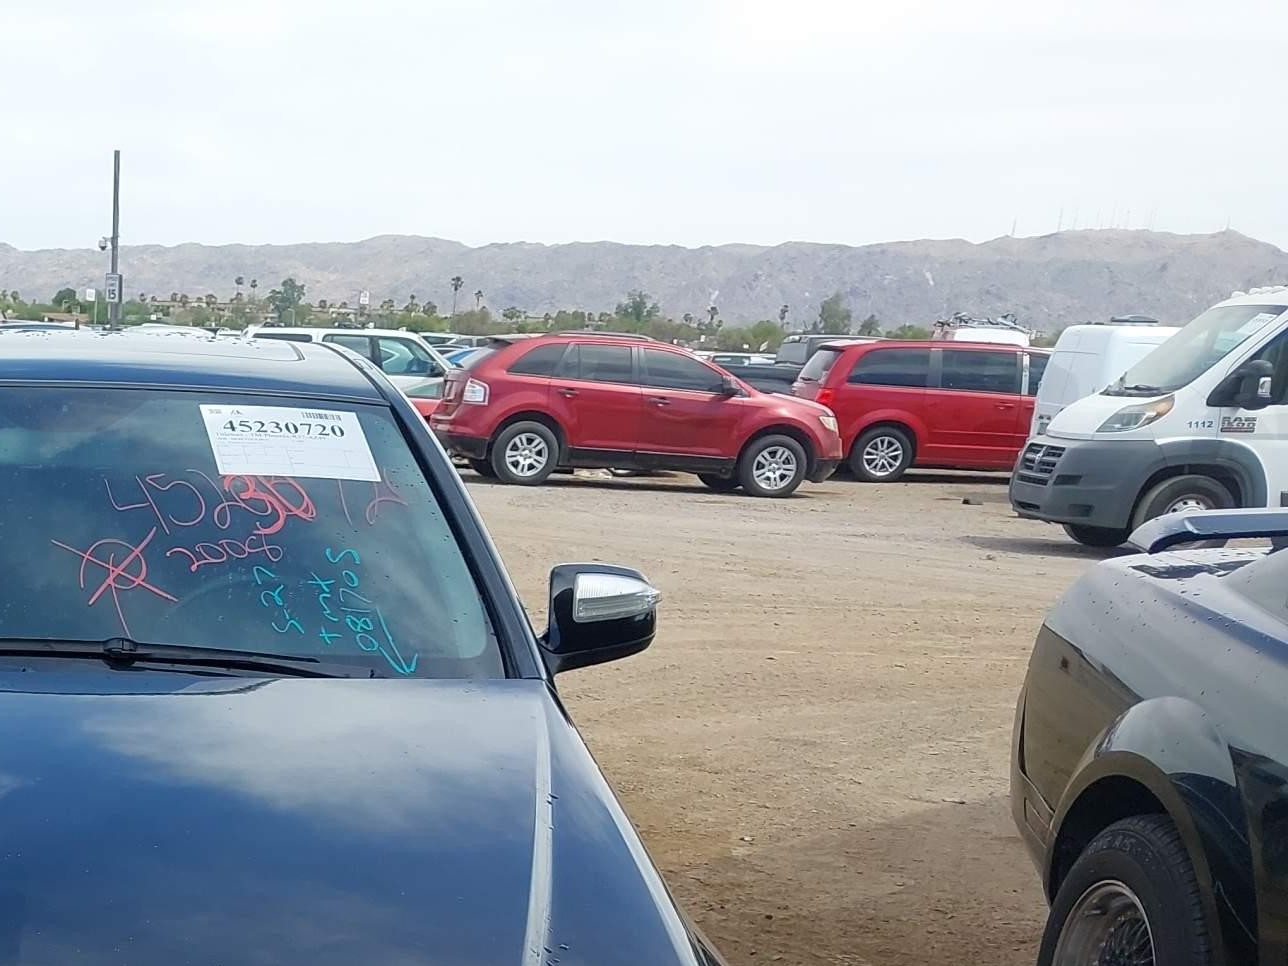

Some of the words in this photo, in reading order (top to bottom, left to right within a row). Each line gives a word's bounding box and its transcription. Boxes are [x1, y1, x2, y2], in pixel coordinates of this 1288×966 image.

[108, 288, 117, 300] 15
[223, 419, 345, 438] 45230720
[1187, 420, 1214, 428] 1112
